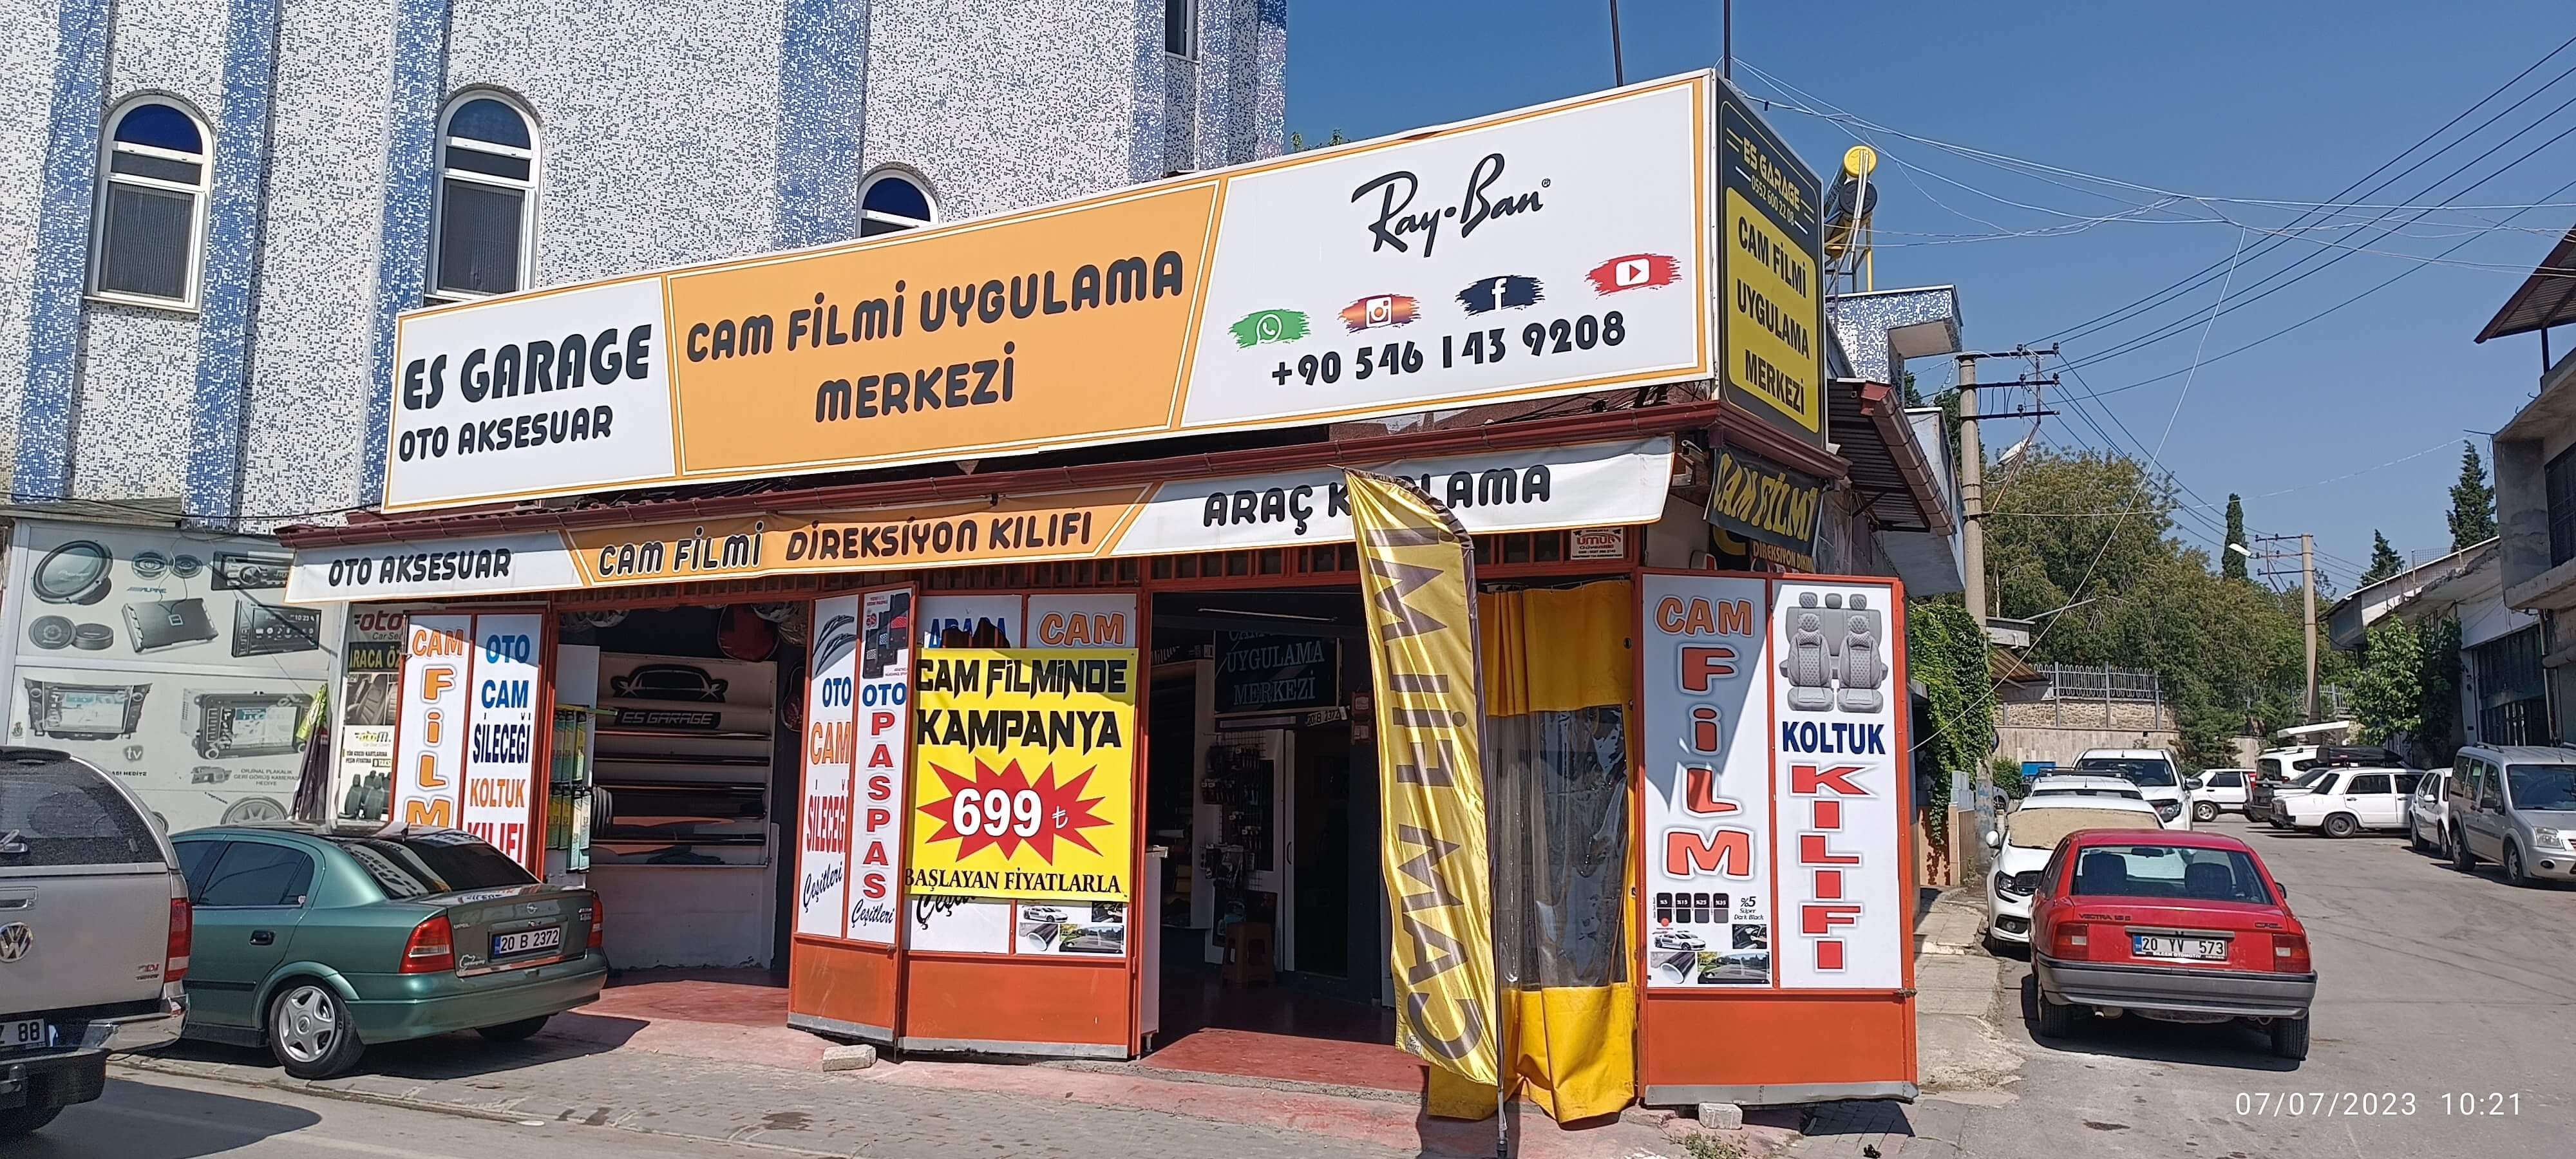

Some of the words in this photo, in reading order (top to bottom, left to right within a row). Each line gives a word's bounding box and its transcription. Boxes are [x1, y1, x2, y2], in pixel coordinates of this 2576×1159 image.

[1743, 137, 1757, 171] ES
[1759, 154, 1800, 212] GARAGE
[1751, 174, 1766, 201] 0552
[1767, 189, 1778, 211] 600
[1779, 200, 1786, 220] 22
[1786, 207, 1795, 225] 08
[1738, 216, 1770, 268] CAM
[1773, 241, 1806, 299] FİLMİ
[687, 314, 773, 362] CAM
[788, 280, 906, 352] FİLMİ
[920, 250, 1184, 332] UYGULAMA
[1737, 278, 1810, 361] UYGULAMA
[403, 354, 447, 410] ES
[460, 323, 652, 403] GARAGE
[1272, 351, 1341, 386] +90
[1356, 341, 1423, 380] 546
[1442, 328, 1506, 368] 143
[1522, 310, 1625, 357] 9208
[816, 341, 1016, 424] MERKEZİ
[1745, 348, 1805, 416] MERKEZİ
[399, 426, 449, 462] OTO
[458, 405, 613, 455] AKSESUAR
[1203, 484, 1313, 536] ARAÇ
[1328, 464, 1551, 517] KAMA
[1714, 453, 1758, 522] CAM
[1751, 472, 1819, 542] FİLMİ
[598, 542, 664, 577] CAM
[674, 520, 766, 572] FİLMİ
[786, 516, 978, 561] DİREKSİYON
[989, 511, 1092, 550] KILIFI
[328, 558, 372, 587] OTO
[379, 548, 512, 584] AKSESUAR
[1039, 612, 1124, 646] CAM
[1655, 596, 1753, 637] CAM
[412, 628, 465, 657] CAM
[486, 635, 531, 664] OTO
[1226, 640, 1325, 673] UYGULAMA
[481, 680, 529, 708] CAM
[822, 677, 852, 708] OTO
[862, 684, 907, 706] OTO
[916, 659, 980, 701] CAM
[986, 659, 1128, 701] FİLMİNDE
[1233, 670, 1316, 706] MERKEZİ
[473, 713, 531, 764] SİLECEĞİ
[621, 711, 646, 723] ES
[647, 712, 714, 725] GARAGE
[917, 709, 1122, 756] KAMPANYA
[1782, 722, 1886, 755] KOLTUK
[810, 722, 851, 765] CAM
[1667, 647, 1750, 878] FİLM
[469, 778, 526, 808] KOLTUK
[863, 711, 896, 900] PASPAS
[952, 788, 1042, 837] 699
[467, 822, 524, 863] IFI
[803, 861, 842, 913] Çeşitleri
[904, 869, 999, 891] BAŞLAYAN
[1005, 867, 1121, 894] FİYATLARLA
[1791, 765, 1873, 970] KILIFI
[851, 899, 895, 928] Çeşitleri
[1740, 896, 1756, 907] %5
[501, 936, 515, 952] 20
[520, 934, 528, 948] B
[533, 930, 558, 947] 2372
[2143, 938, 2157, 951] 20
[2169, 939, 2184, 952] YV
[2199, 941, 2224, 955] 573
[18, 1021, 40, 1042] 88
